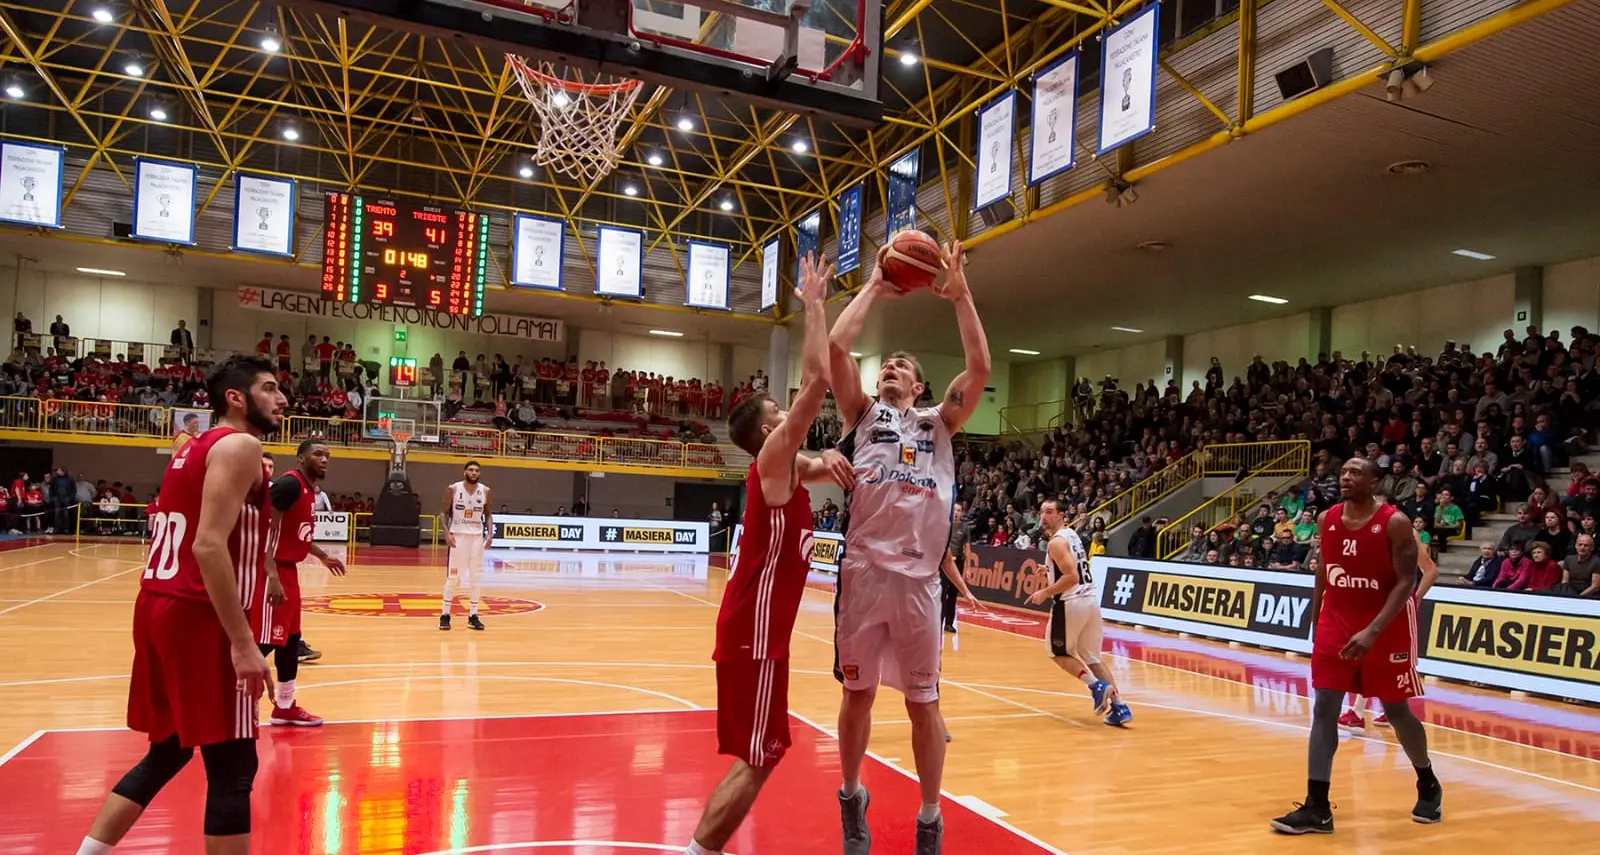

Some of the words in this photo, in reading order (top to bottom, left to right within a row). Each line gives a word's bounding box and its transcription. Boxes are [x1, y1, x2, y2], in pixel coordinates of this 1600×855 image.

[365, 204, 397, 216] TRENTO
[412, 211, 447, 224] TRIESTE
[372, 220, 393, 237] 39
[425, 228, 446, 244] 41
[400, 269, 407, 279] 2
[376, 284, 387, 298] 3
[430, 290, 441, 304] 5
[397, 366, 414, 382] 14
[506, 526, 557, 538] MASIERA
[560, 527, 583, 539] DAY
[605, 528, 618, 541] #
[625, 530, 672, 542] MASIERA
[675, 531, 695, 542] DAY
[144, 511, 188, 580] 20
[813, 541, 835, 560] SIERA
[1342, 538, 1357, 557] 24
[1077, 560, 1093, 586] 13
[1113, 573, 1135, 606] #
[1147, 580, 1245, 620] MASIERA
[1255, 593, 1310, 629] DAY
[1435, 614, 1600, 671] MASIER
[1396, 672, 1410, 689] 24
